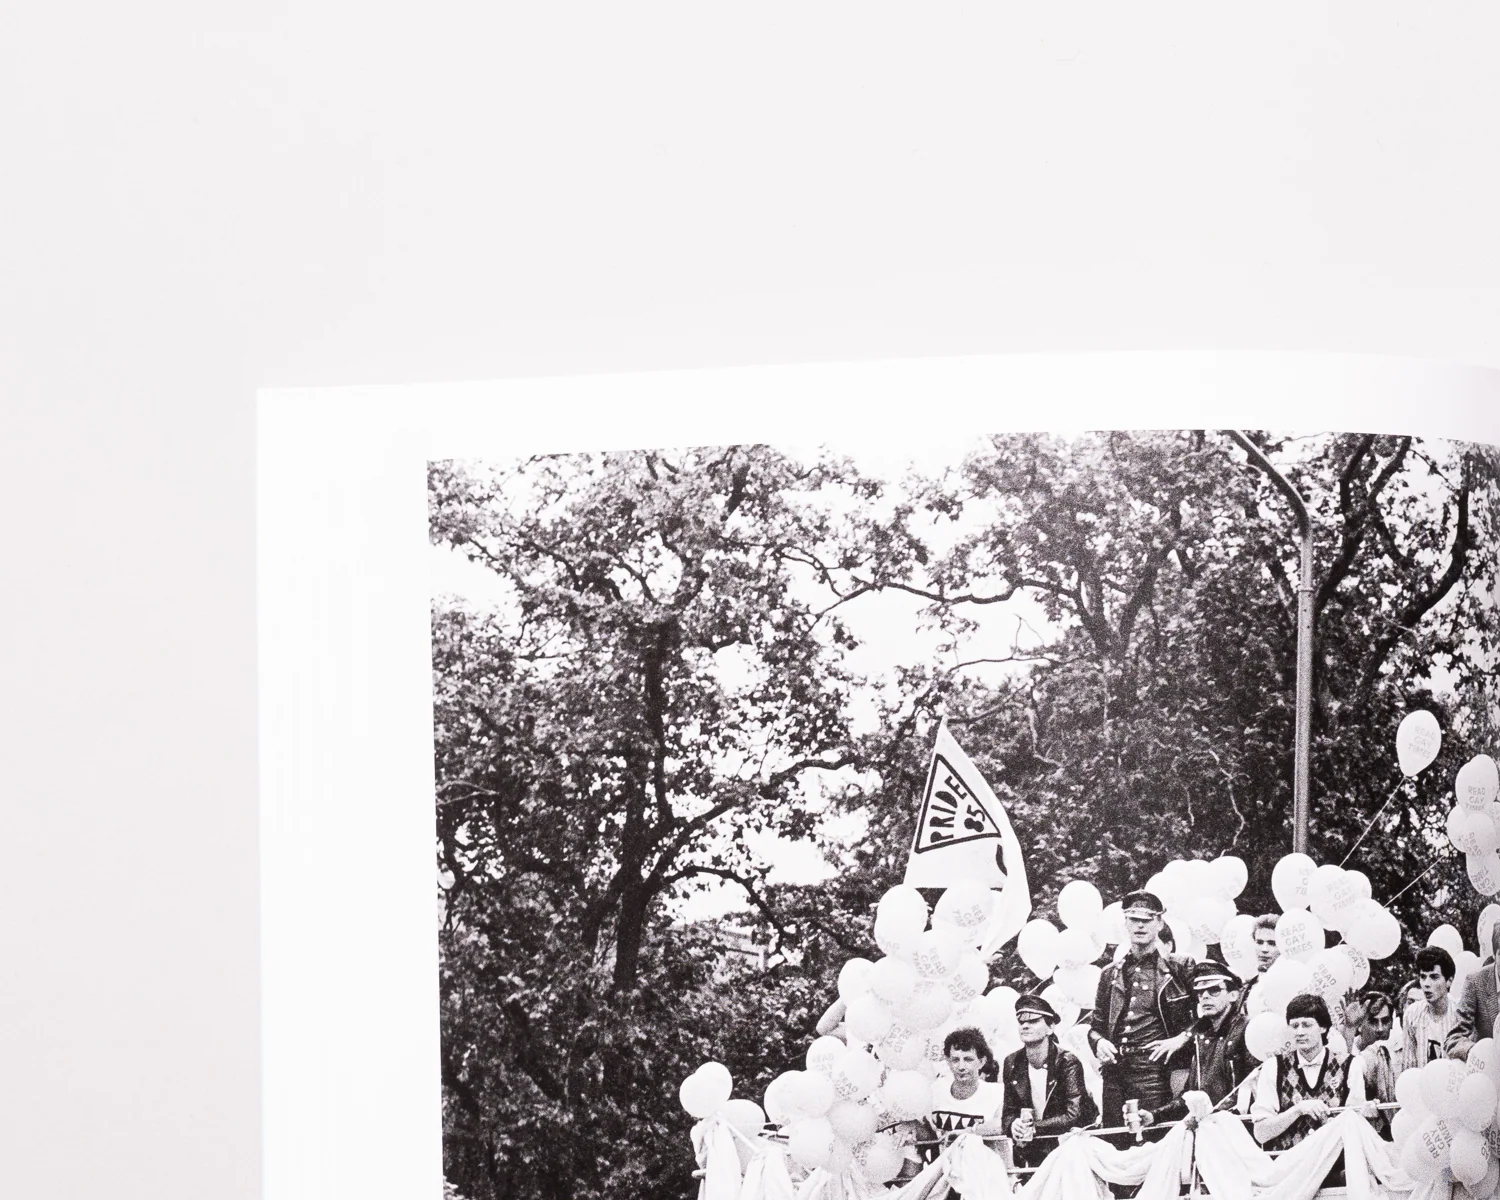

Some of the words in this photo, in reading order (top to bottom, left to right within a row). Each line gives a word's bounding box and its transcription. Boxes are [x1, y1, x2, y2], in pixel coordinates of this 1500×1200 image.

[929, 775, 968, 844] PRIDE
[963, 803, 986, 834] 85
[1423, 1132, 1440, 1159] READ
[1430, 1129, 1445, 1150] GAY
